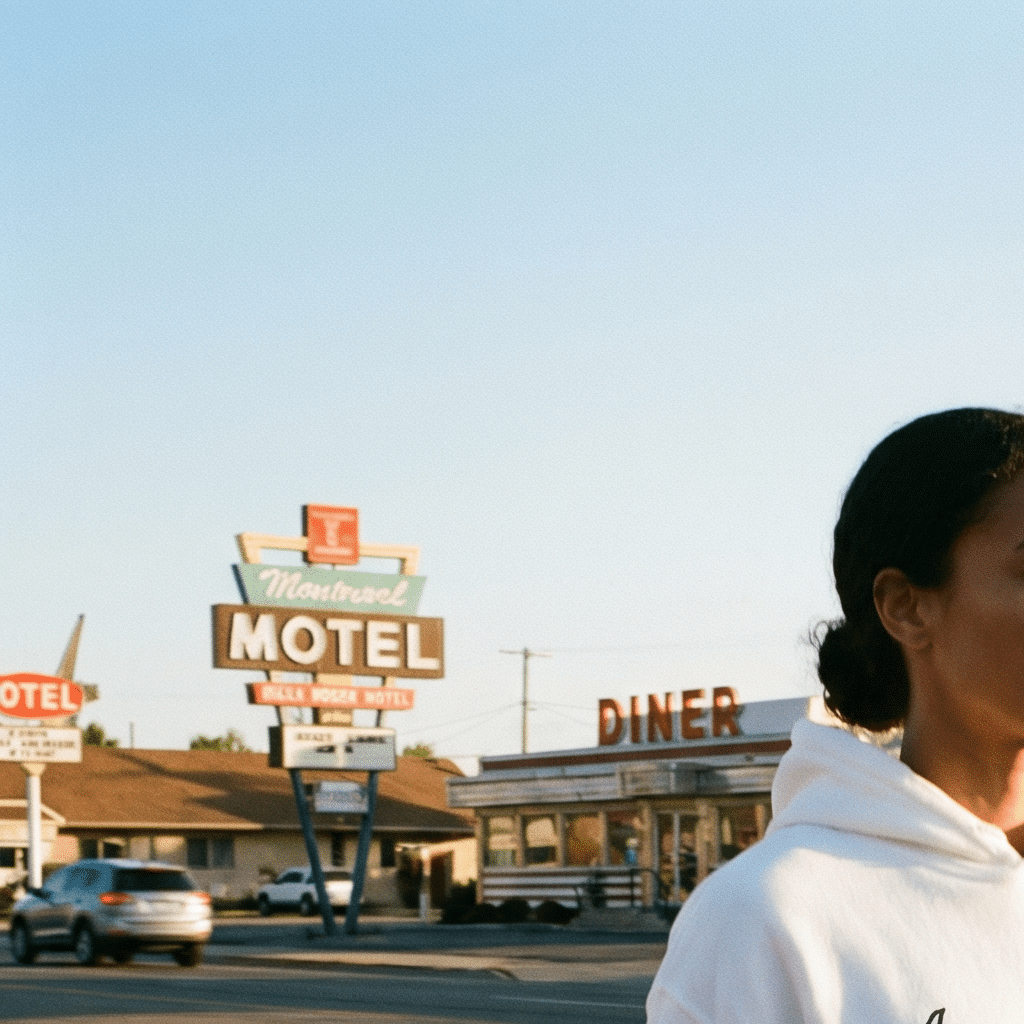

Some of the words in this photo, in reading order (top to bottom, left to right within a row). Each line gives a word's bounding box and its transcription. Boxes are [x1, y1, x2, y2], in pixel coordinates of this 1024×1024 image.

[229, 612, 440, 670] MOTEL
[0, 680, 79, 711] OTEL
[598, 686, 745, 746] DINER
